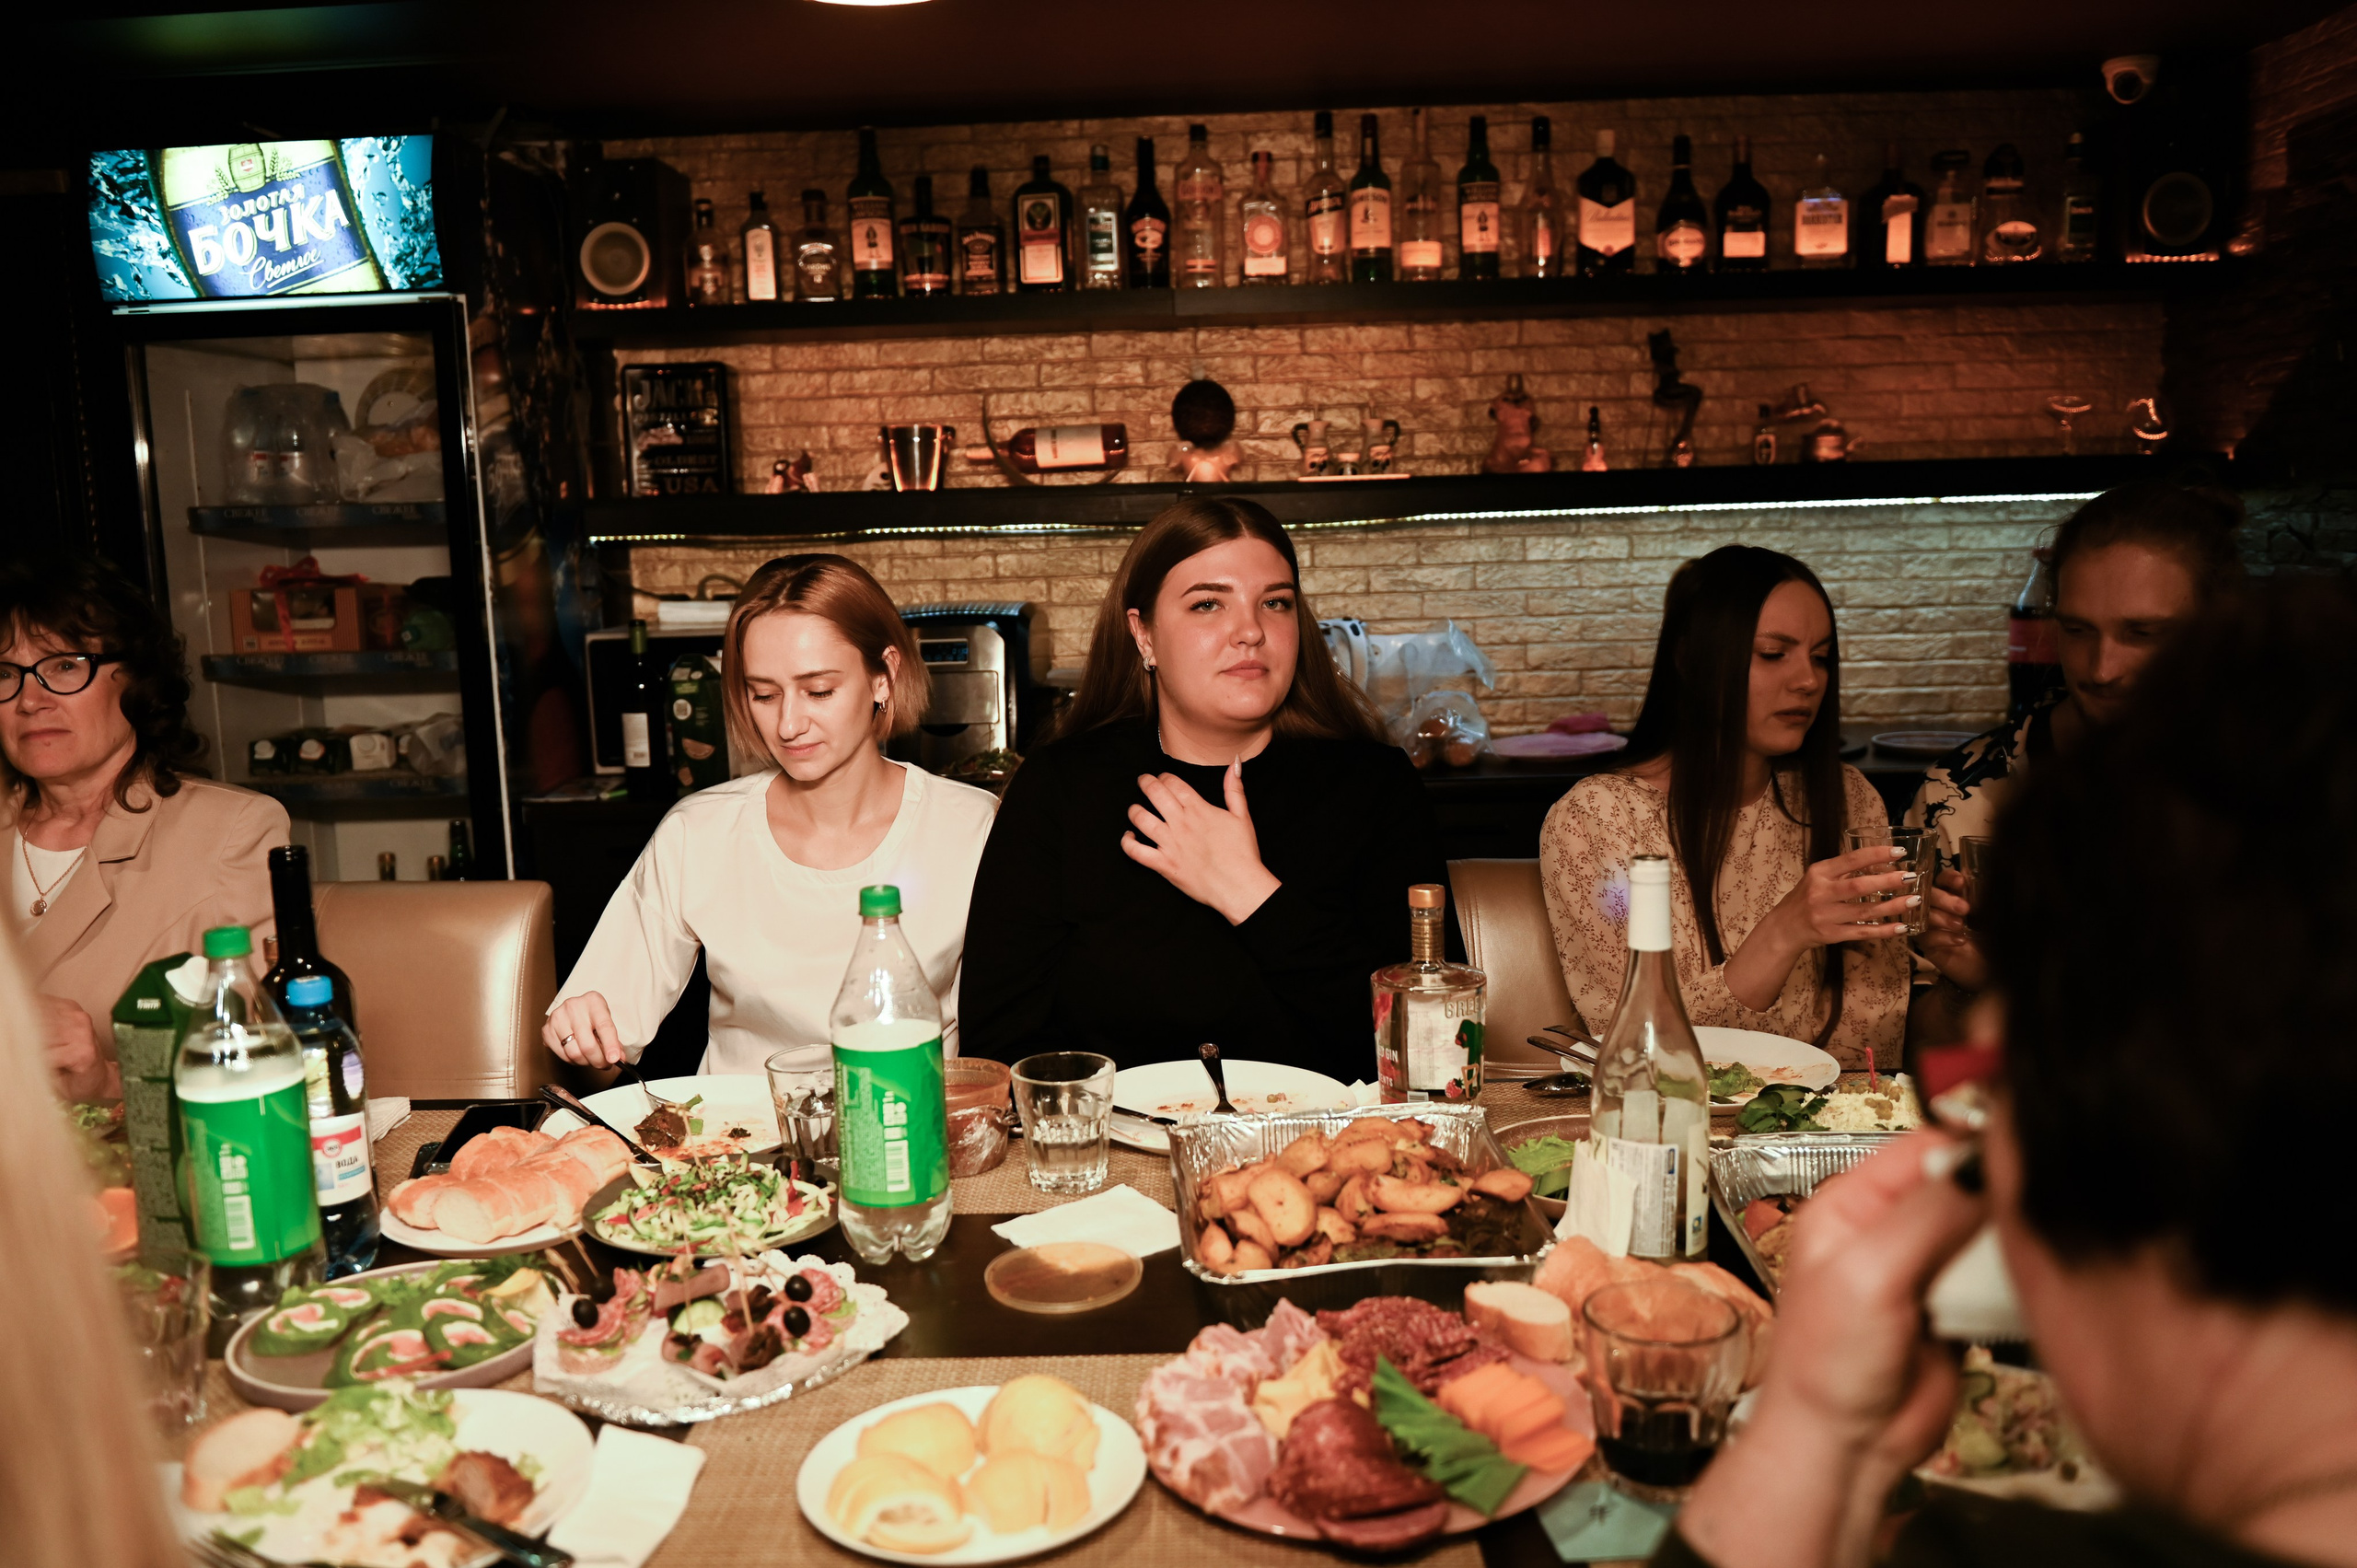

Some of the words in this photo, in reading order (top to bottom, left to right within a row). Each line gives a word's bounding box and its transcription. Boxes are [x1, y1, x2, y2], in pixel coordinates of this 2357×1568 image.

[219, 183, 305, 226] ЗОЛОТАЯ
[188, 189, 351, 276] БОЧКА
[238, 248, 321, 291] Светлое
[664, 476, 719, 495] USA
[1386, 1047, 1399, 1063] GIN
